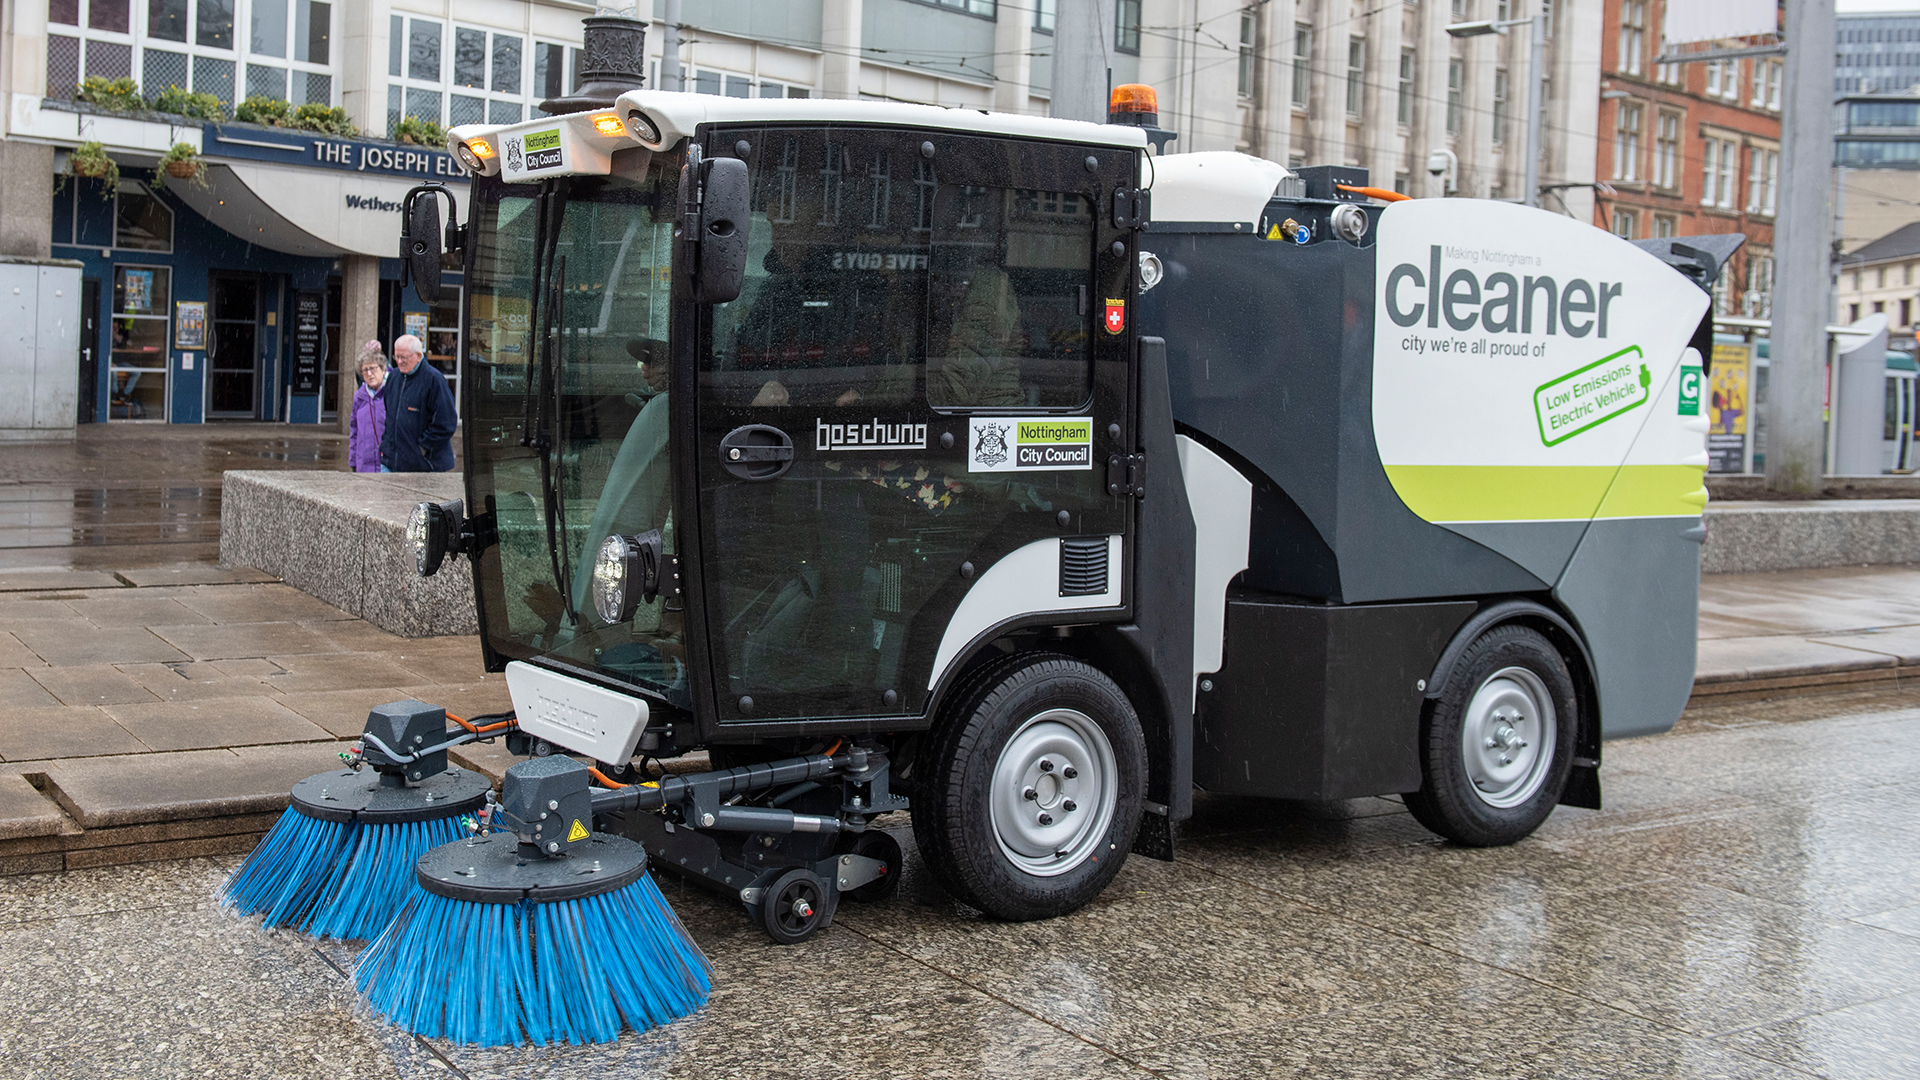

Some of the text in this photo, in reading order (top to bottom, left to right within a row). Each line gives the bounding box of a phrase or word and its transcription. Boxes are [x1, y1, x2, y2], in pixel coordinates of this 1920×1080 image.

[525, 134, 560, 148] Nottingham
[313, 140, 351, 164] THE
[357, 147, 428, 173] JOSEPH
[527, 151, 561, 167] City Council
[1445, 246, 1542, 267] Making Nottingham a
[1385, 244, 1623, 339] cleaner
[1401, 332, 1546, 358] city we're all proud of
[1545, 364, 1632, 410] Low Emissions
[1682, 372, 1698, 399] G
[1550, 382, 1636, 430] Electric Vehicle
[816, 417, 927, 450] boschung
[1020, 425, 1087, 441] Nottingham
[1019, 447, 1087, 464] City Council
